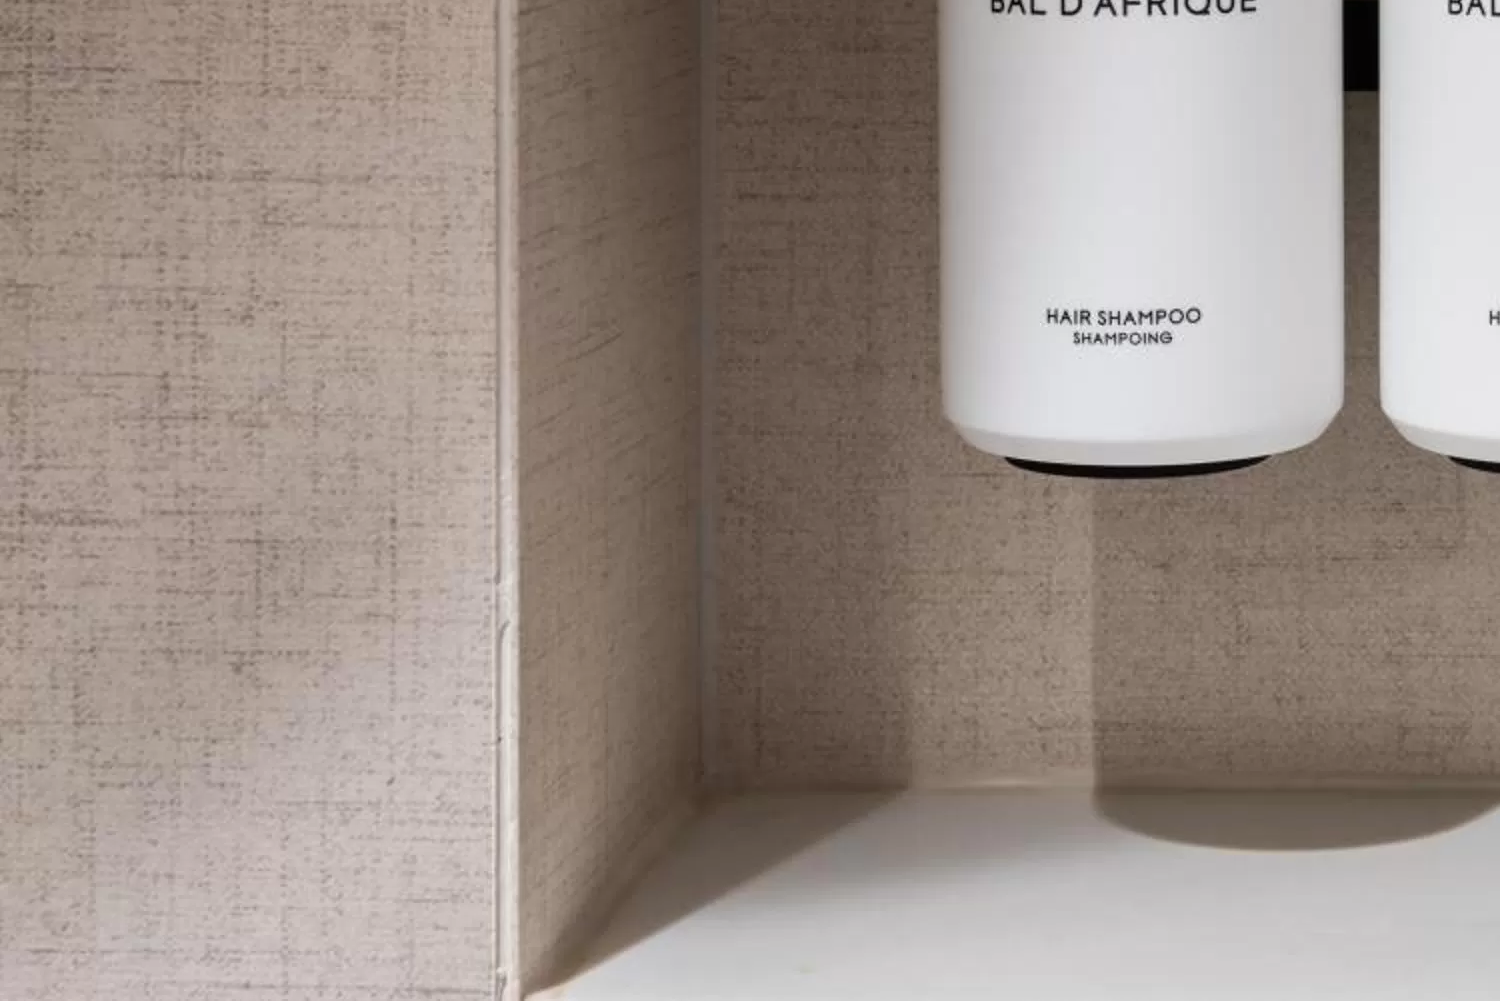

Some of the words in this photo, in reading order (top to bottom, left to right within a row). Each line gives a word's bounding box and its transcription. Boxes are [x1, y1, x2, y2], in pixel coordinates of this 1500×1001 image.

[1046, 308, 1092, 326] HAIR
[1097, 307, 1202, 327] SHAMPOO
[1073, 330, 1173, 346] SHAMPOING
